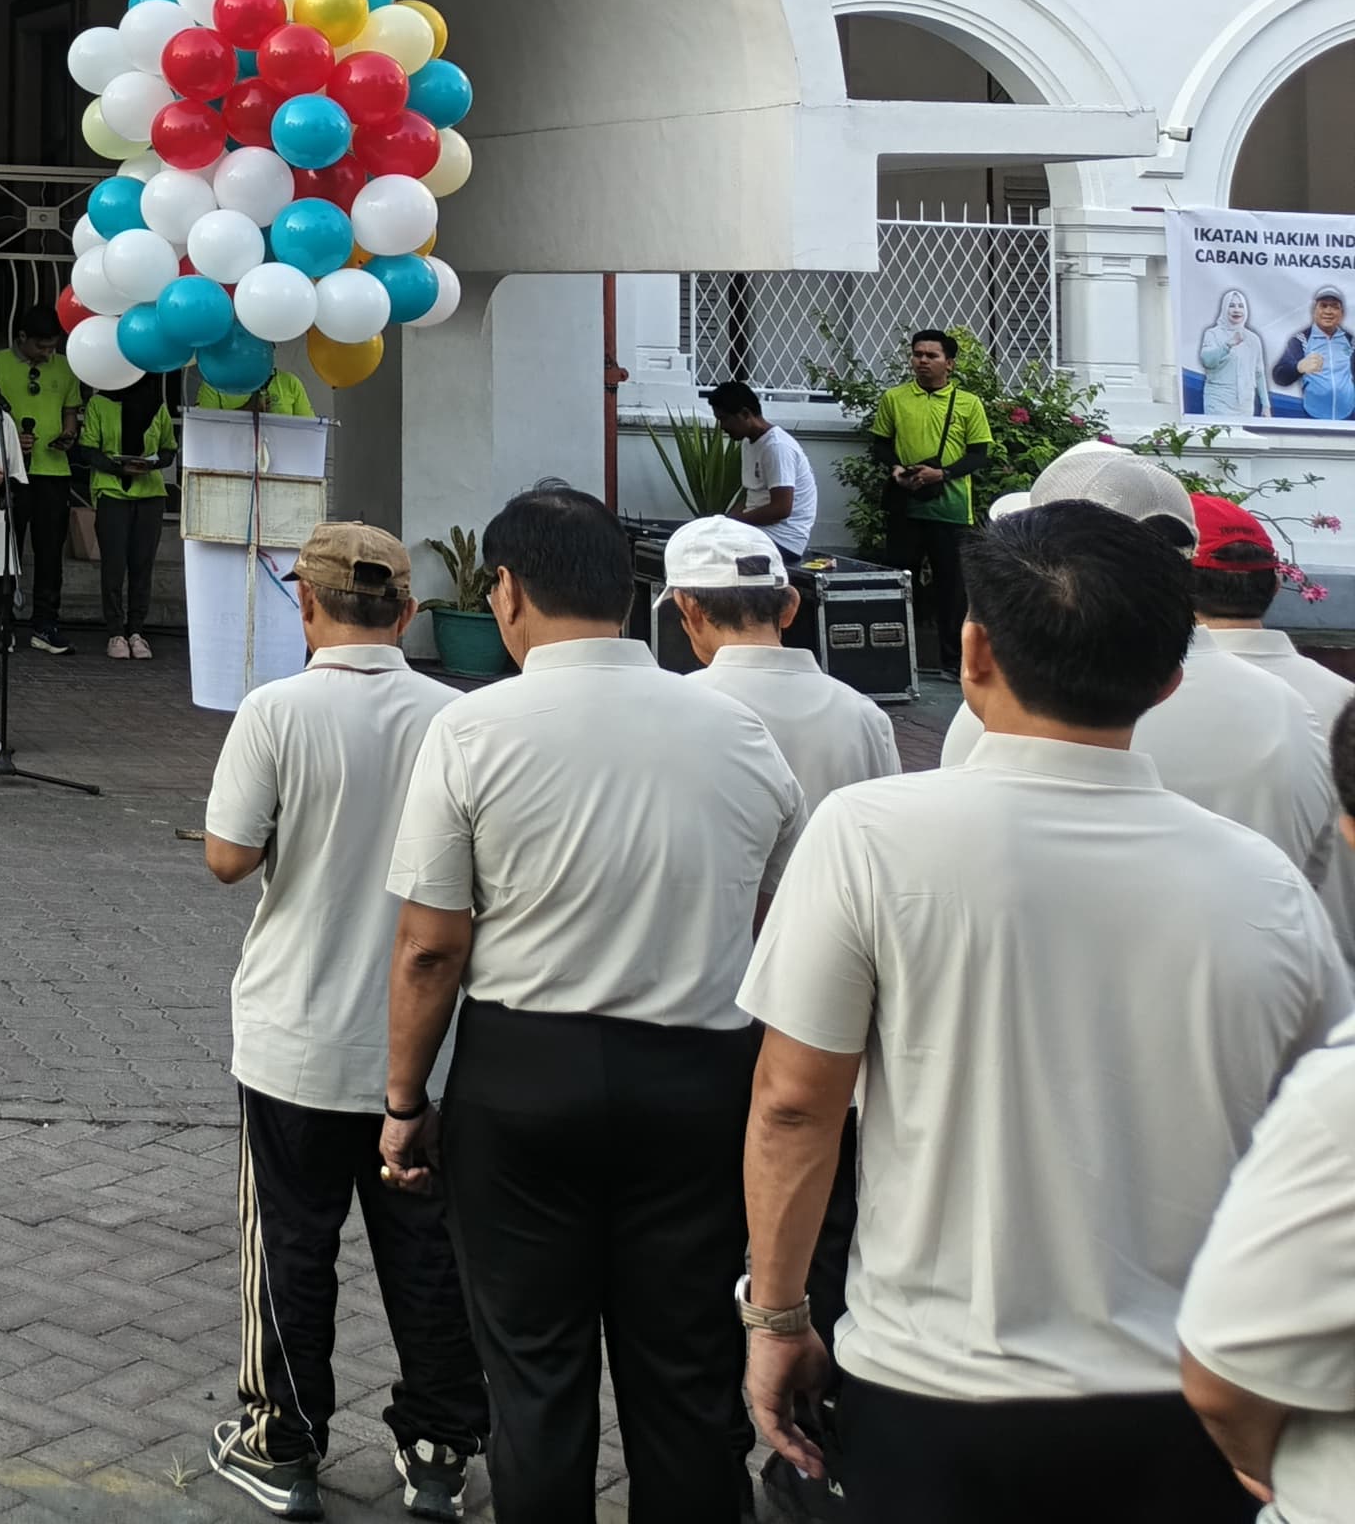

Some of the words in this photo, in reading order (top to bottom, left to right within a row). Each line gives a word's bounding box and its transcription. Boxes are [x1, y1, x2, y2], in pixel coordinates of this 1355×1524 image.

[1194, 227, 1258, 244] IKATAN
[1263, 231, 1320, 246] HAKIM
[1195, 249, 1268, 266] CABANG
